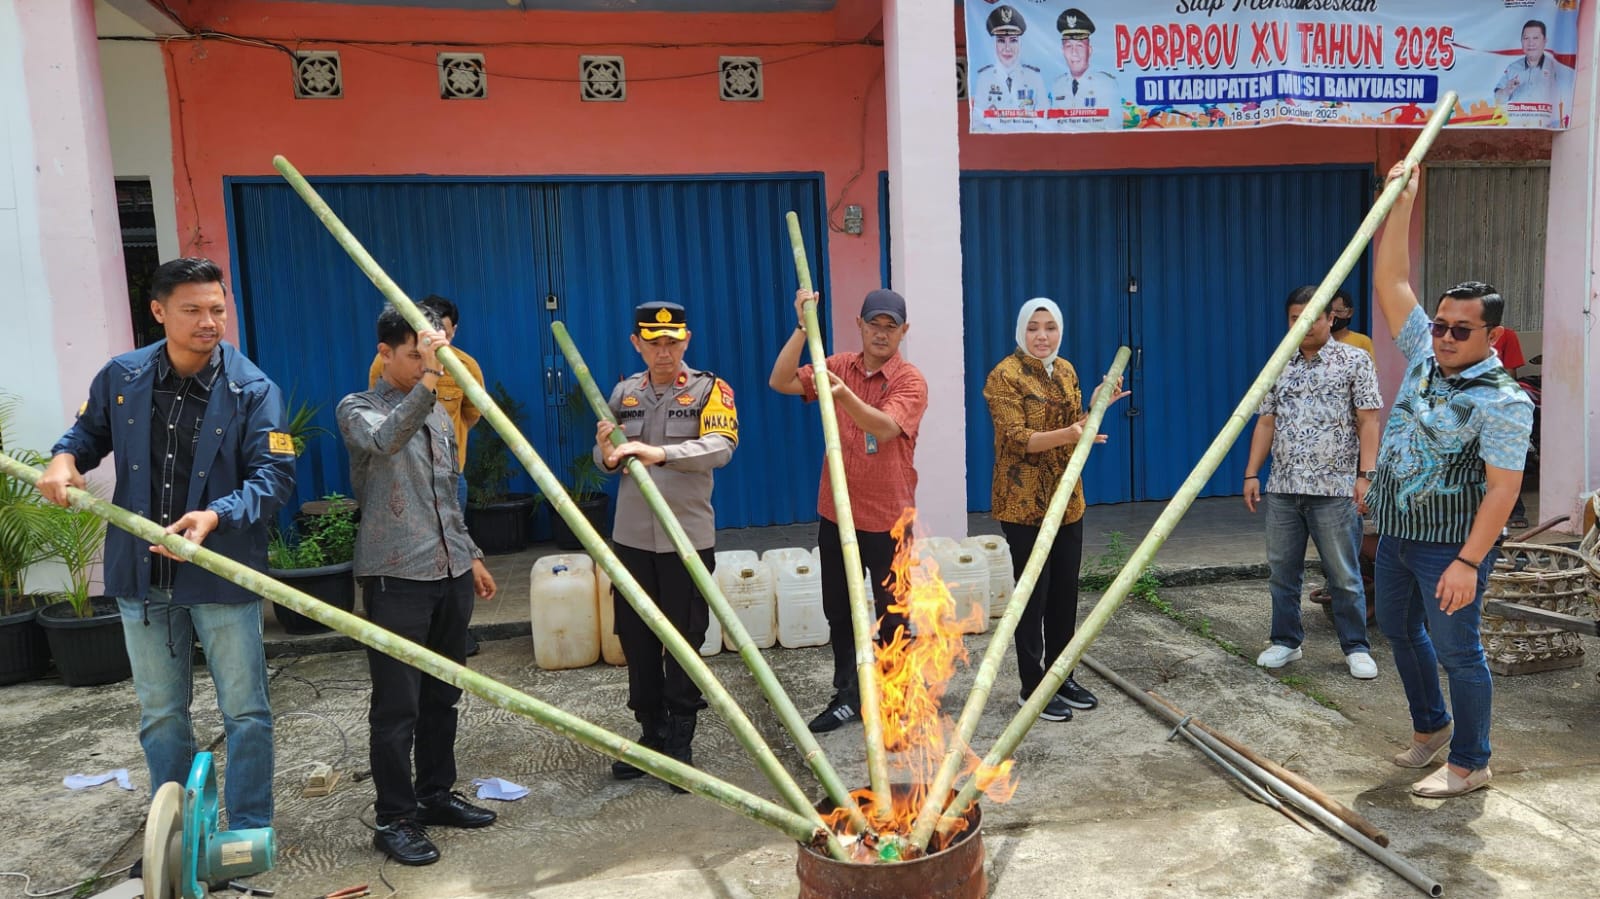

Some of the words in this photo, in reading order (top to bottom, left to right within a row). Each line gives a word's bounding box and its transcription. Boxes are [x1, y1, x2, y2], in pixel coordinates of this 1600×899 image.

[1176, 0, 1224, 17] Siap
[1115, 22, 1240, 70] PORPROV
[1250, 20, 1289, 66] XV
[1297, 22, 1384, 67] TAHUN
[1394, 25, 1456, 70] 2025
[1144, 79, 1165, 101] DI
[1168, 75, 1273, 101] KABUPATEN
[1278, 73, 1321, 97] MUSI
[1324, 76, 1425, 99] BANYUASIN
[1230, 111, 1243, 121] 18
[1263, 108, 1276, 118] 31
[1315, 109, 1339, 119] 2025
[704, 415, 728, 431] WAKA
